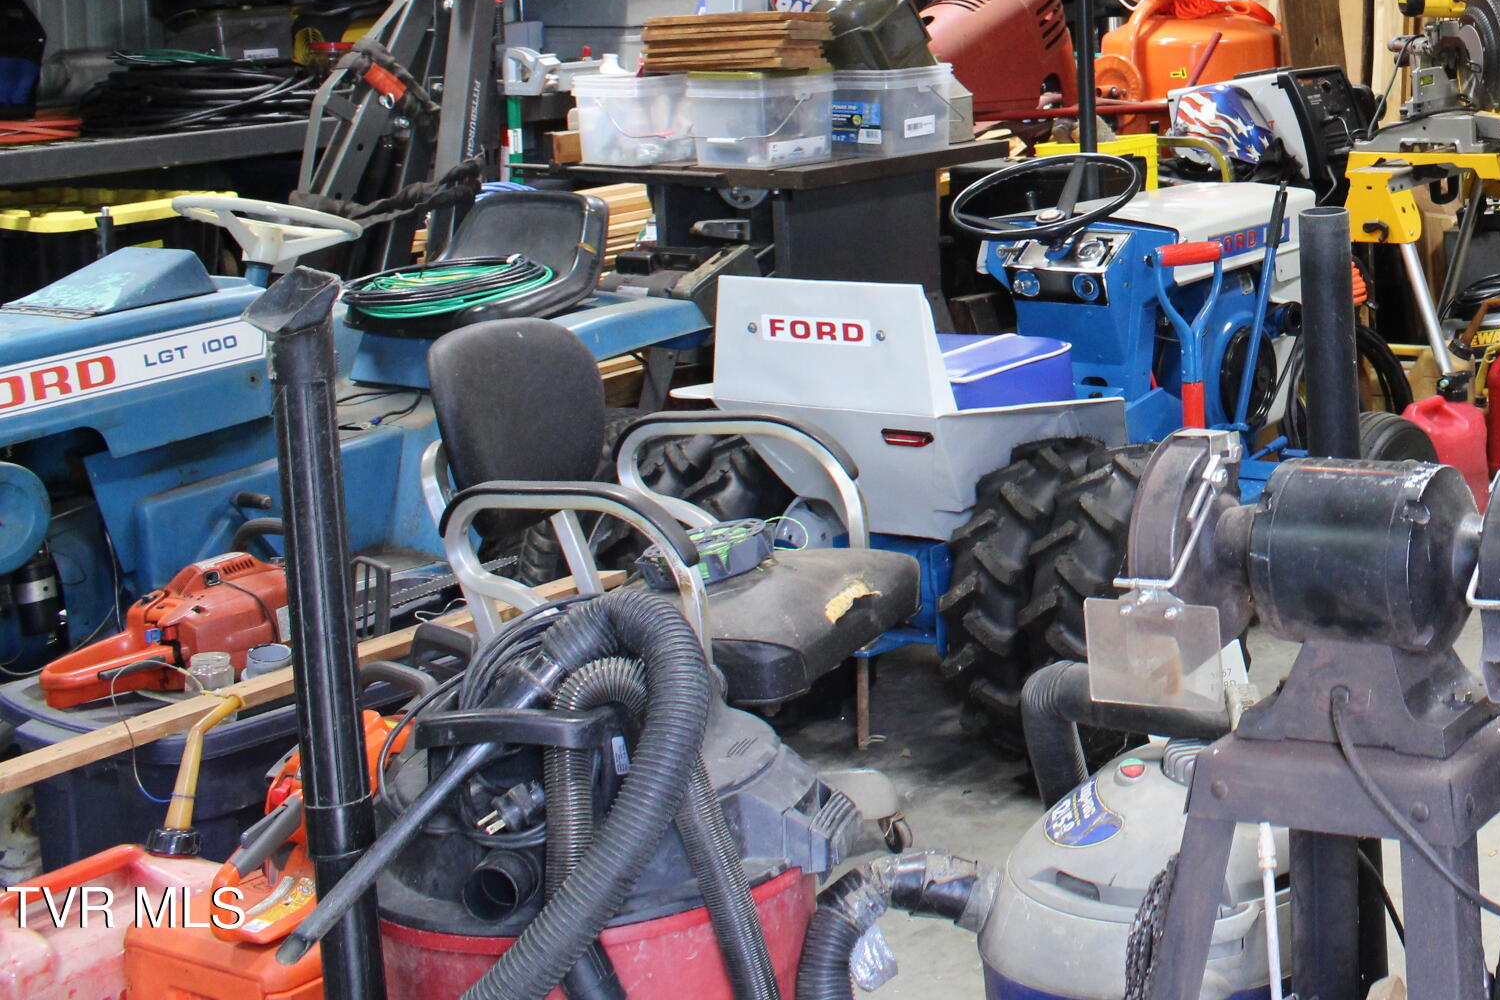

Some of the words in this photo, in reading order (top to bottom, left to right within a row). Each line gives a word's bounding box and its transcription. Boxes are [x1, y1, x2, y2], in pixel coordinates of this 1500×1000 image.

[1222, 230, 1258, 254] ORD
[769, 317, 865, 343] FORD
[0, 355, 116, 410] ORD
[143, 345, 189, 368] LGT
[202, 334, 239, 355] 100
